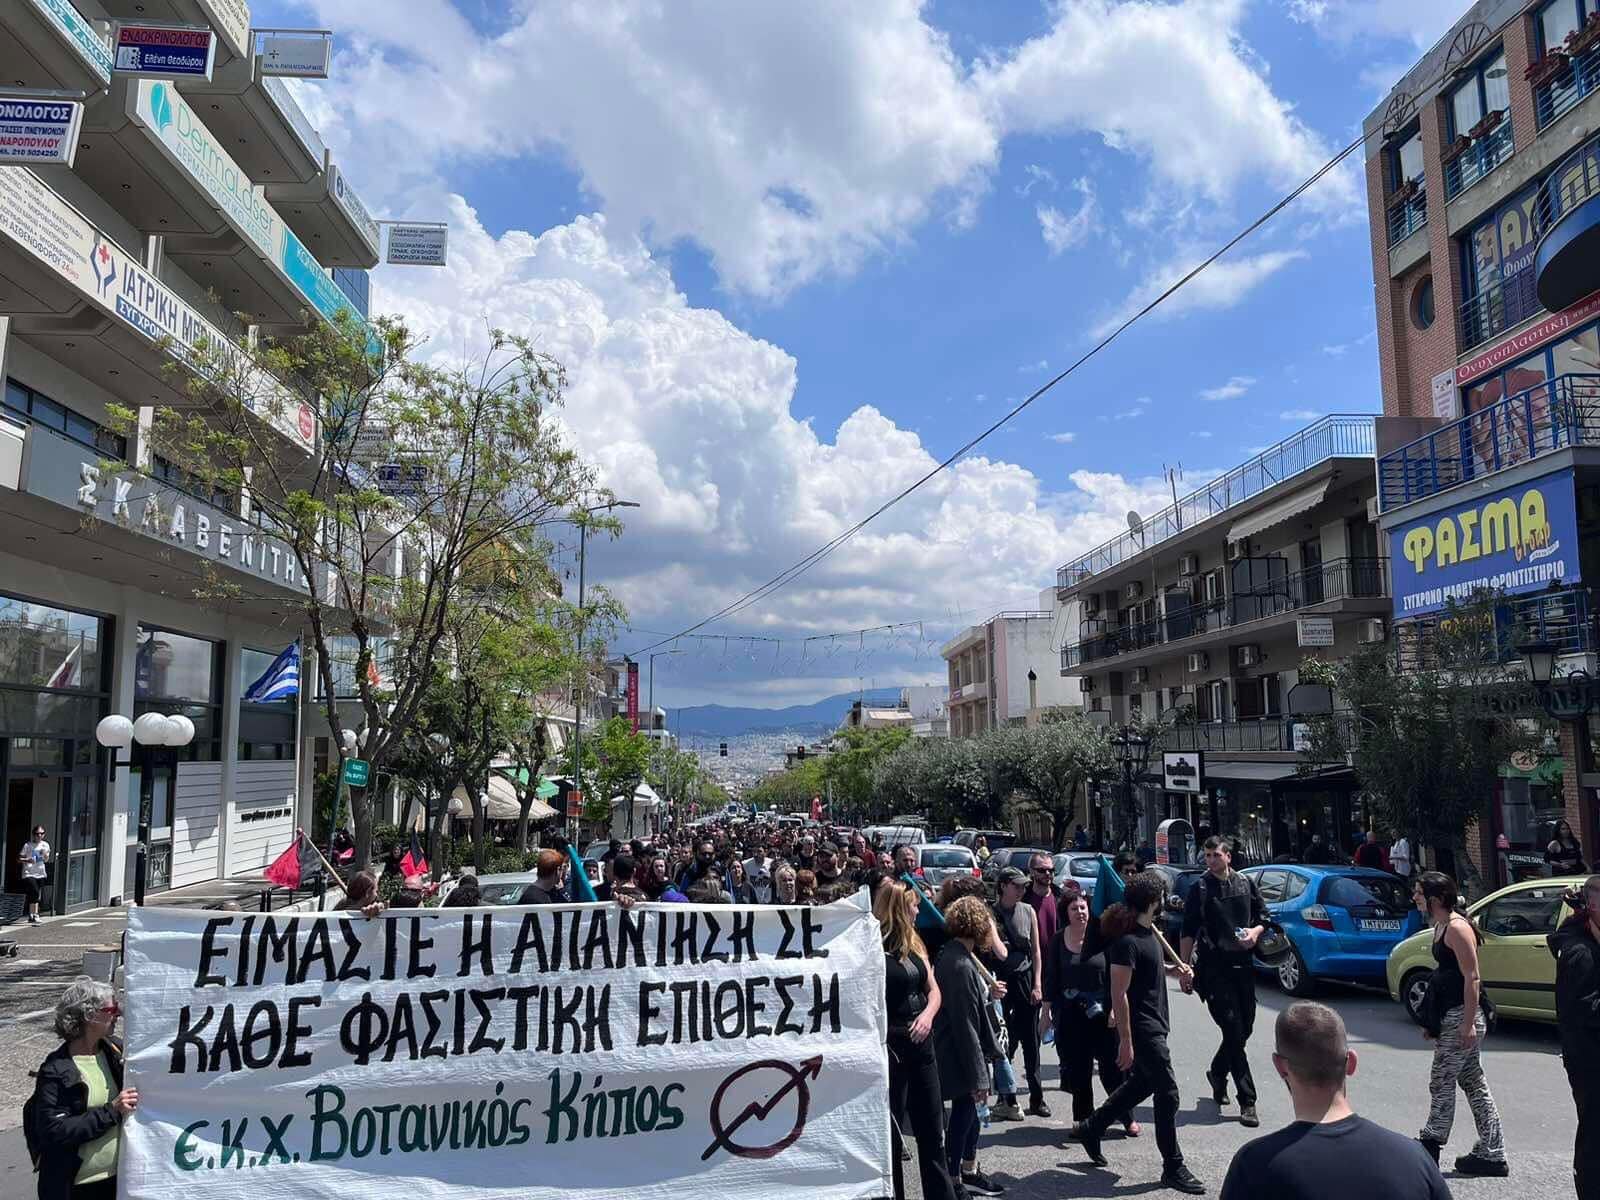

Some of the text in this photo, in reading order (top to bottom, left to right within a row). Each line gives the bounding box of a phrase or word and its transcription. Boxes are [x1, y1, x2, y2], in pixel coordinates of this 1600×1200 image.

[120, 28, 209, 47] ΕΝΔΟΚΡΙΝΟΛΟΓΟΣ
[0, 125, 22, 134] ΤΑΣΕΙΣ
[119, 302, 168, 341] ΣΥΓΧΡΟΝ
[122, 262, 178, 334] ΙΑΤΡΙΚΗ
[1459, 313, 1569, 378] Ονυχοπλαστική
[1403, 489, 1550, 574] ΦΑΣΜΑ
[1403, 588, 1442, 611] ΣΥΓΧΡΟΝΟ
[195, 908, 829, 988] ΕΙΜΑΣΤΕ Η ΑΠΑΝΤΗΣΗ ΣΕ
[168, 973, 841, 1073] ΚΑΘΕ ΦΑΣΙΣΤΙΚΗ ΕΠΙΘΕΣΗ
[305, 1081, 531, 1162] Βοτανικός
[542, 1067, 685, 1145] Κήπος
